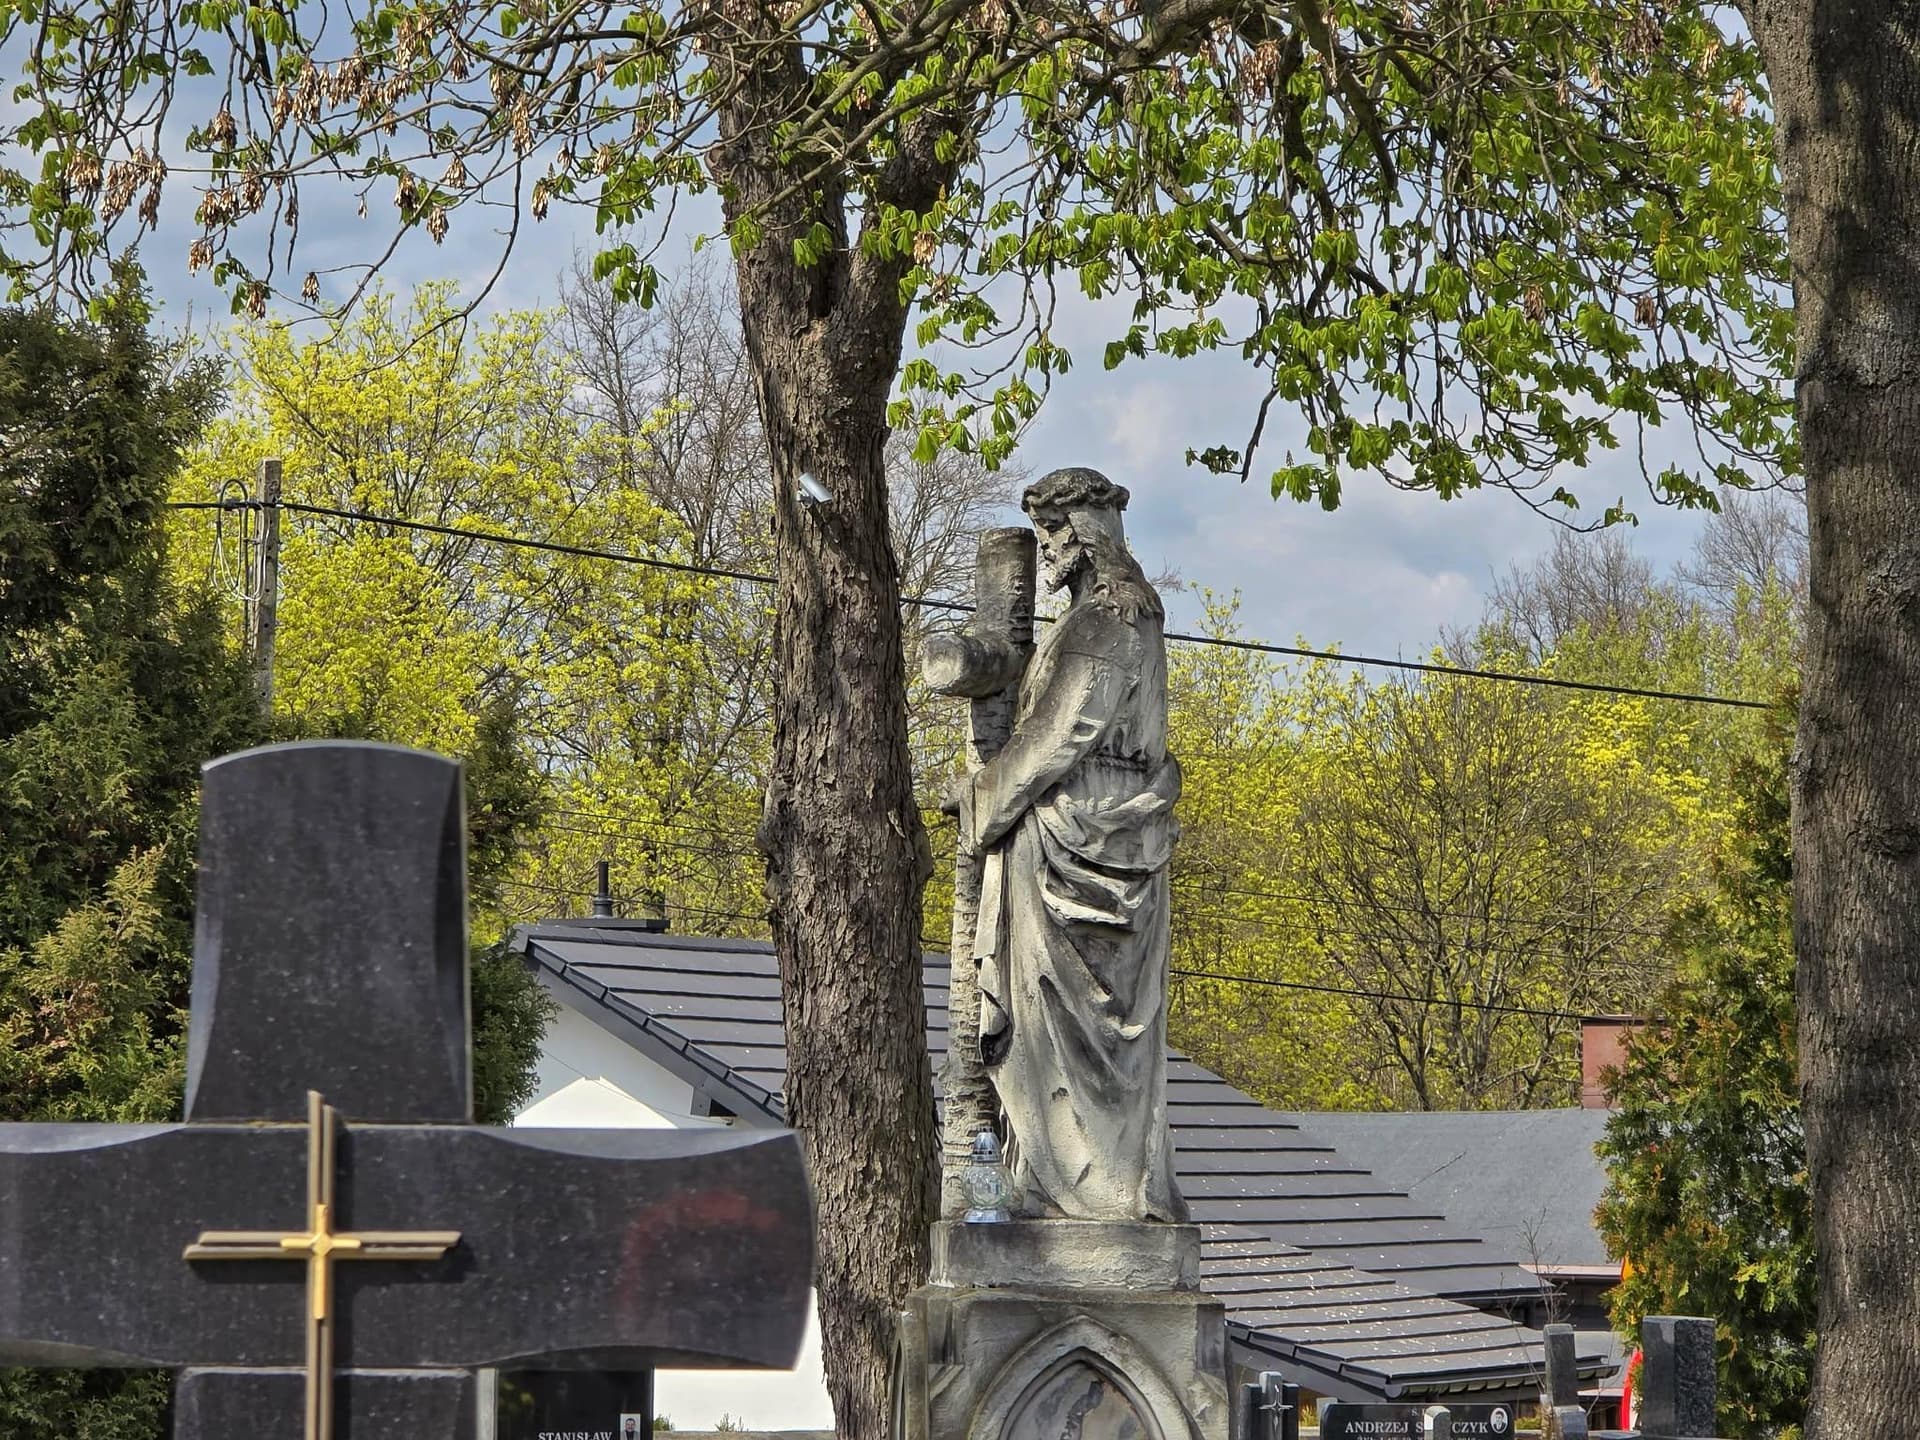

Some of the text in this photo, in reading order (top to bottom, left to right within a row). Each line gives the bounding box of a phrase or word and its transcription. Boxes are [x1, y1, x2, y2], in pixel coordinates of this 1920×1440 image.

[1345, 1421, 1488, 1434] ANDRZEJ SCZYK
[538, 1431, 613, 1440] STANISŁAW
